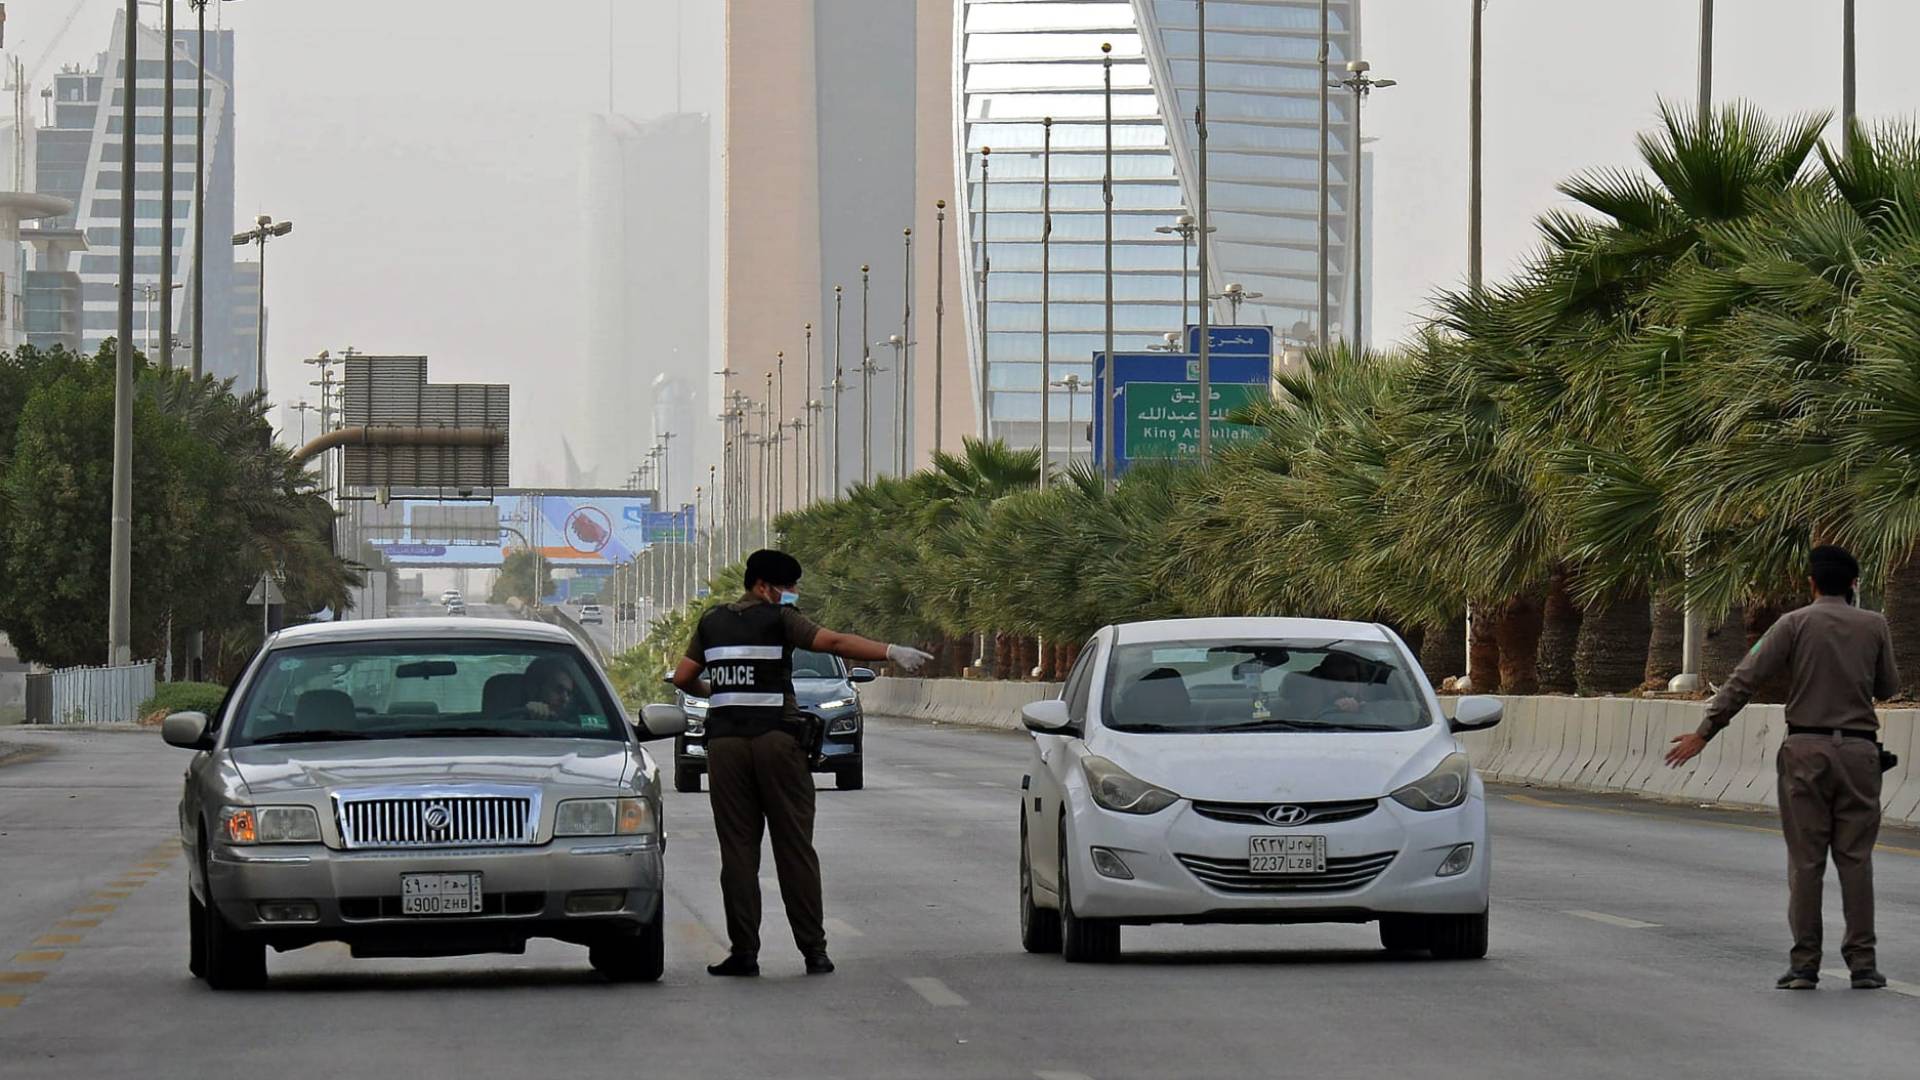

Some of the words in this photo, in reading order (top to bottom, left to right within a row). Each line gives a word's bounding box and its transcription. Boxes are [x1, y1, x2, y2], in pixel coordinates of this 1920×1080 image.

[1208, 334, 1254, 348] مخرج
[1171, 387, 1220, 403] طيق
[1138, 407, 1198, 423] عبدالله
[1144, 427, 1176, 440] King
[1182, 427, 1248, 439] Abullah
[711, 665, 754, 685] POLICE
[1252, 856, 1285, 871] 2237
[1289, 857, 1312, 868] LZB
[444, 898, 468, 909] ZHB
